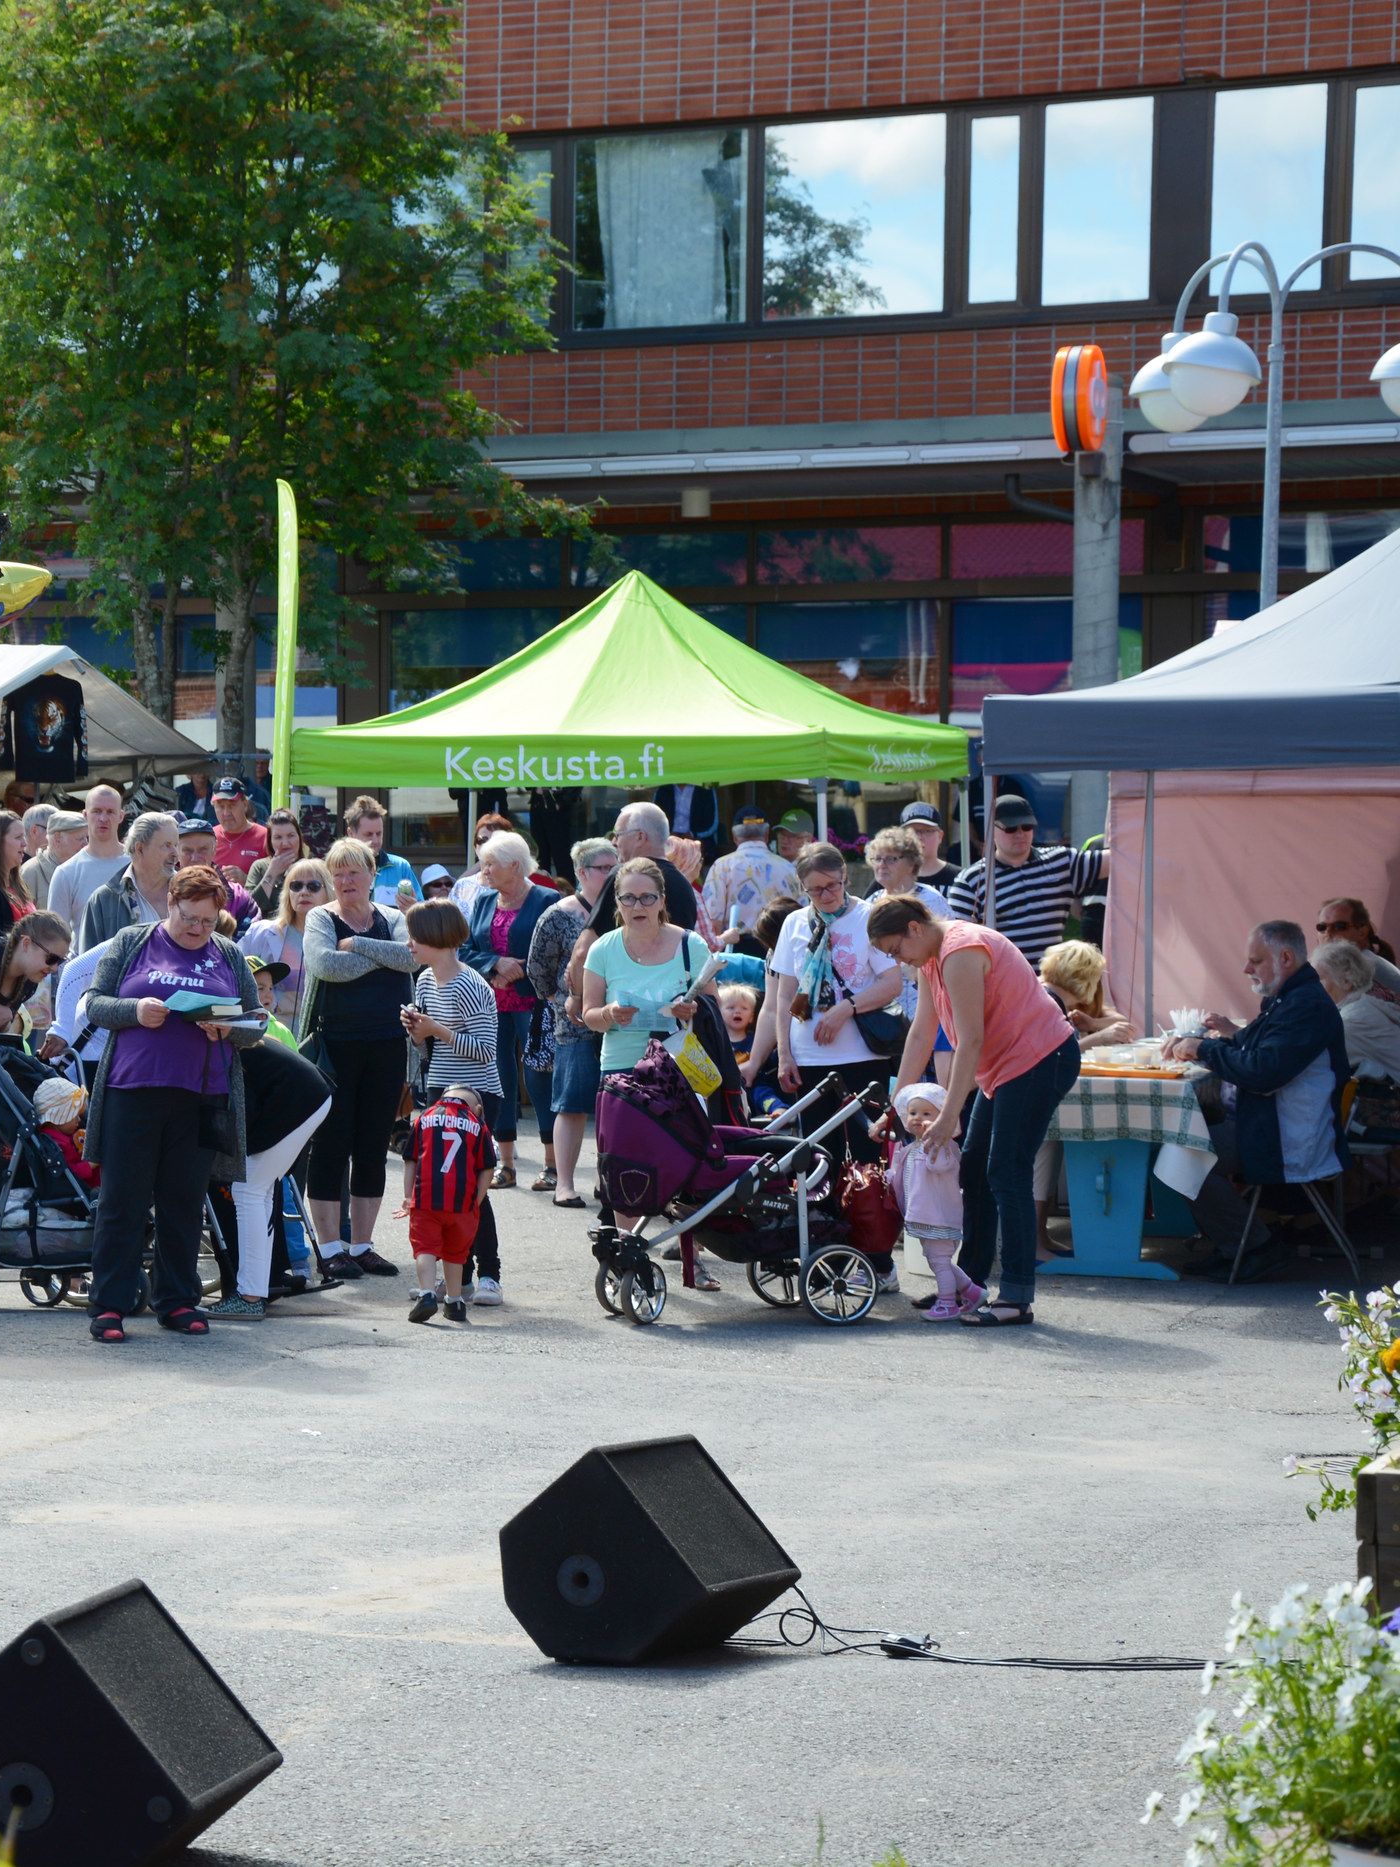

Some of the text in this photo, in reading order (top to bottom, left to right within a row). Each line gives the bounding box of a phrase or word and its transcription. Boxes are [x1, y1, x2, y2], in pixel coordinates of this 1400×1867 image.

[445, 743, 665, 782] Keskusta.fi
[148, 970, 204, 987] Pärnu
[420, 1114, 481, 1137] SHEVCHENKO
[440, 1131, 462, 1173] 7
[762, 1200, 790, 1210] MATRIX
